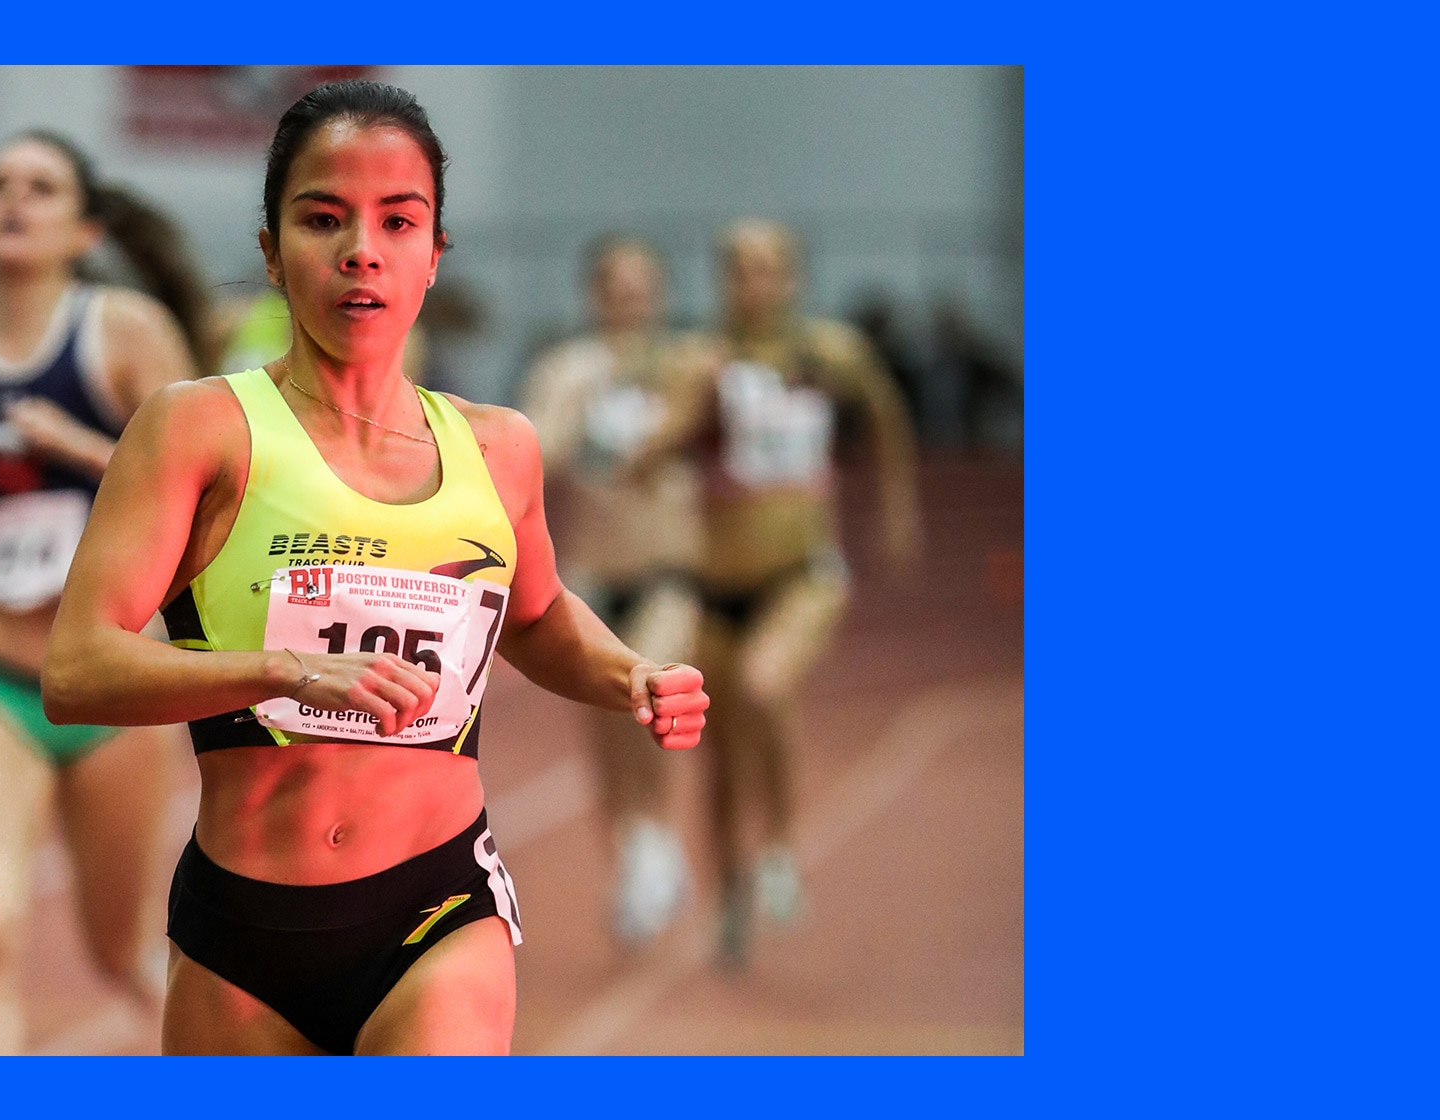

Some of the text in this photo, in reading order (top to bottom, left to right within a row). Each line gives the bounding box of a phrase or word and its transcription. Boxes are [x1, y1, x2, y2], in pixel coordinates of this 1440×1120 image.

[268, 533, 388, 558] BEASTS
[288, 558, 327, 567] TRACK
[288, 568, 333, 600] BU
[337, 573, 466, 597] BOSTON UNIVERSITY
[348, 587, 375, 597] BRUCE
[409, 593, 442, 604] SCARLET
[443, 597, 459, 606] AND
[364, 599, 445, 614] WHITE INVITATIONAL
